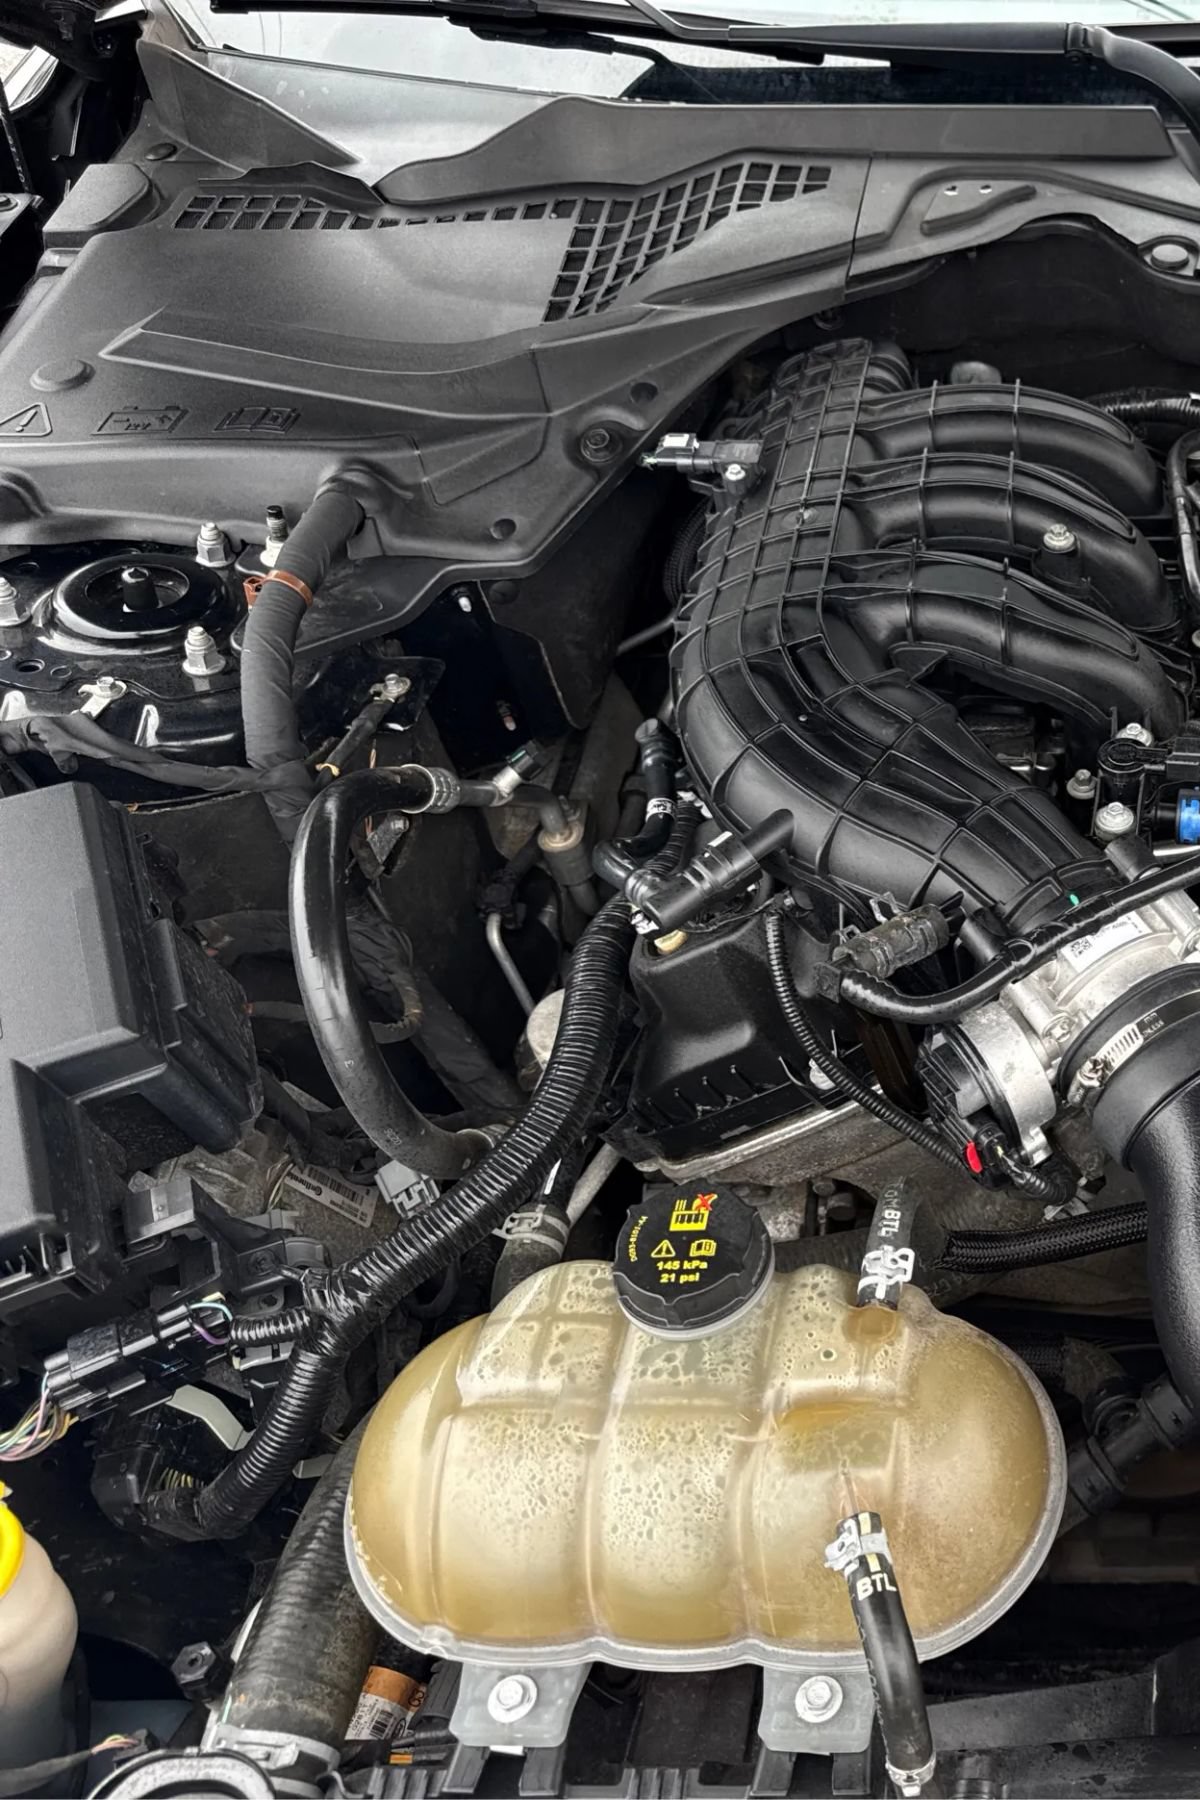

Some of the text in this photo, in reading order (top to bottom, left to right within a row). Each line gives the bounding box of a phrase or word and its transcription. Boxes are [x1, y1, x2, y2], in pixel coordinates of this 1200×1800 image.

[657, 1260, 708, 1271] 145 kPa
[660, 1272, 700, 1284] 21 psi
[856, 1572, 897, 1601] BTL
